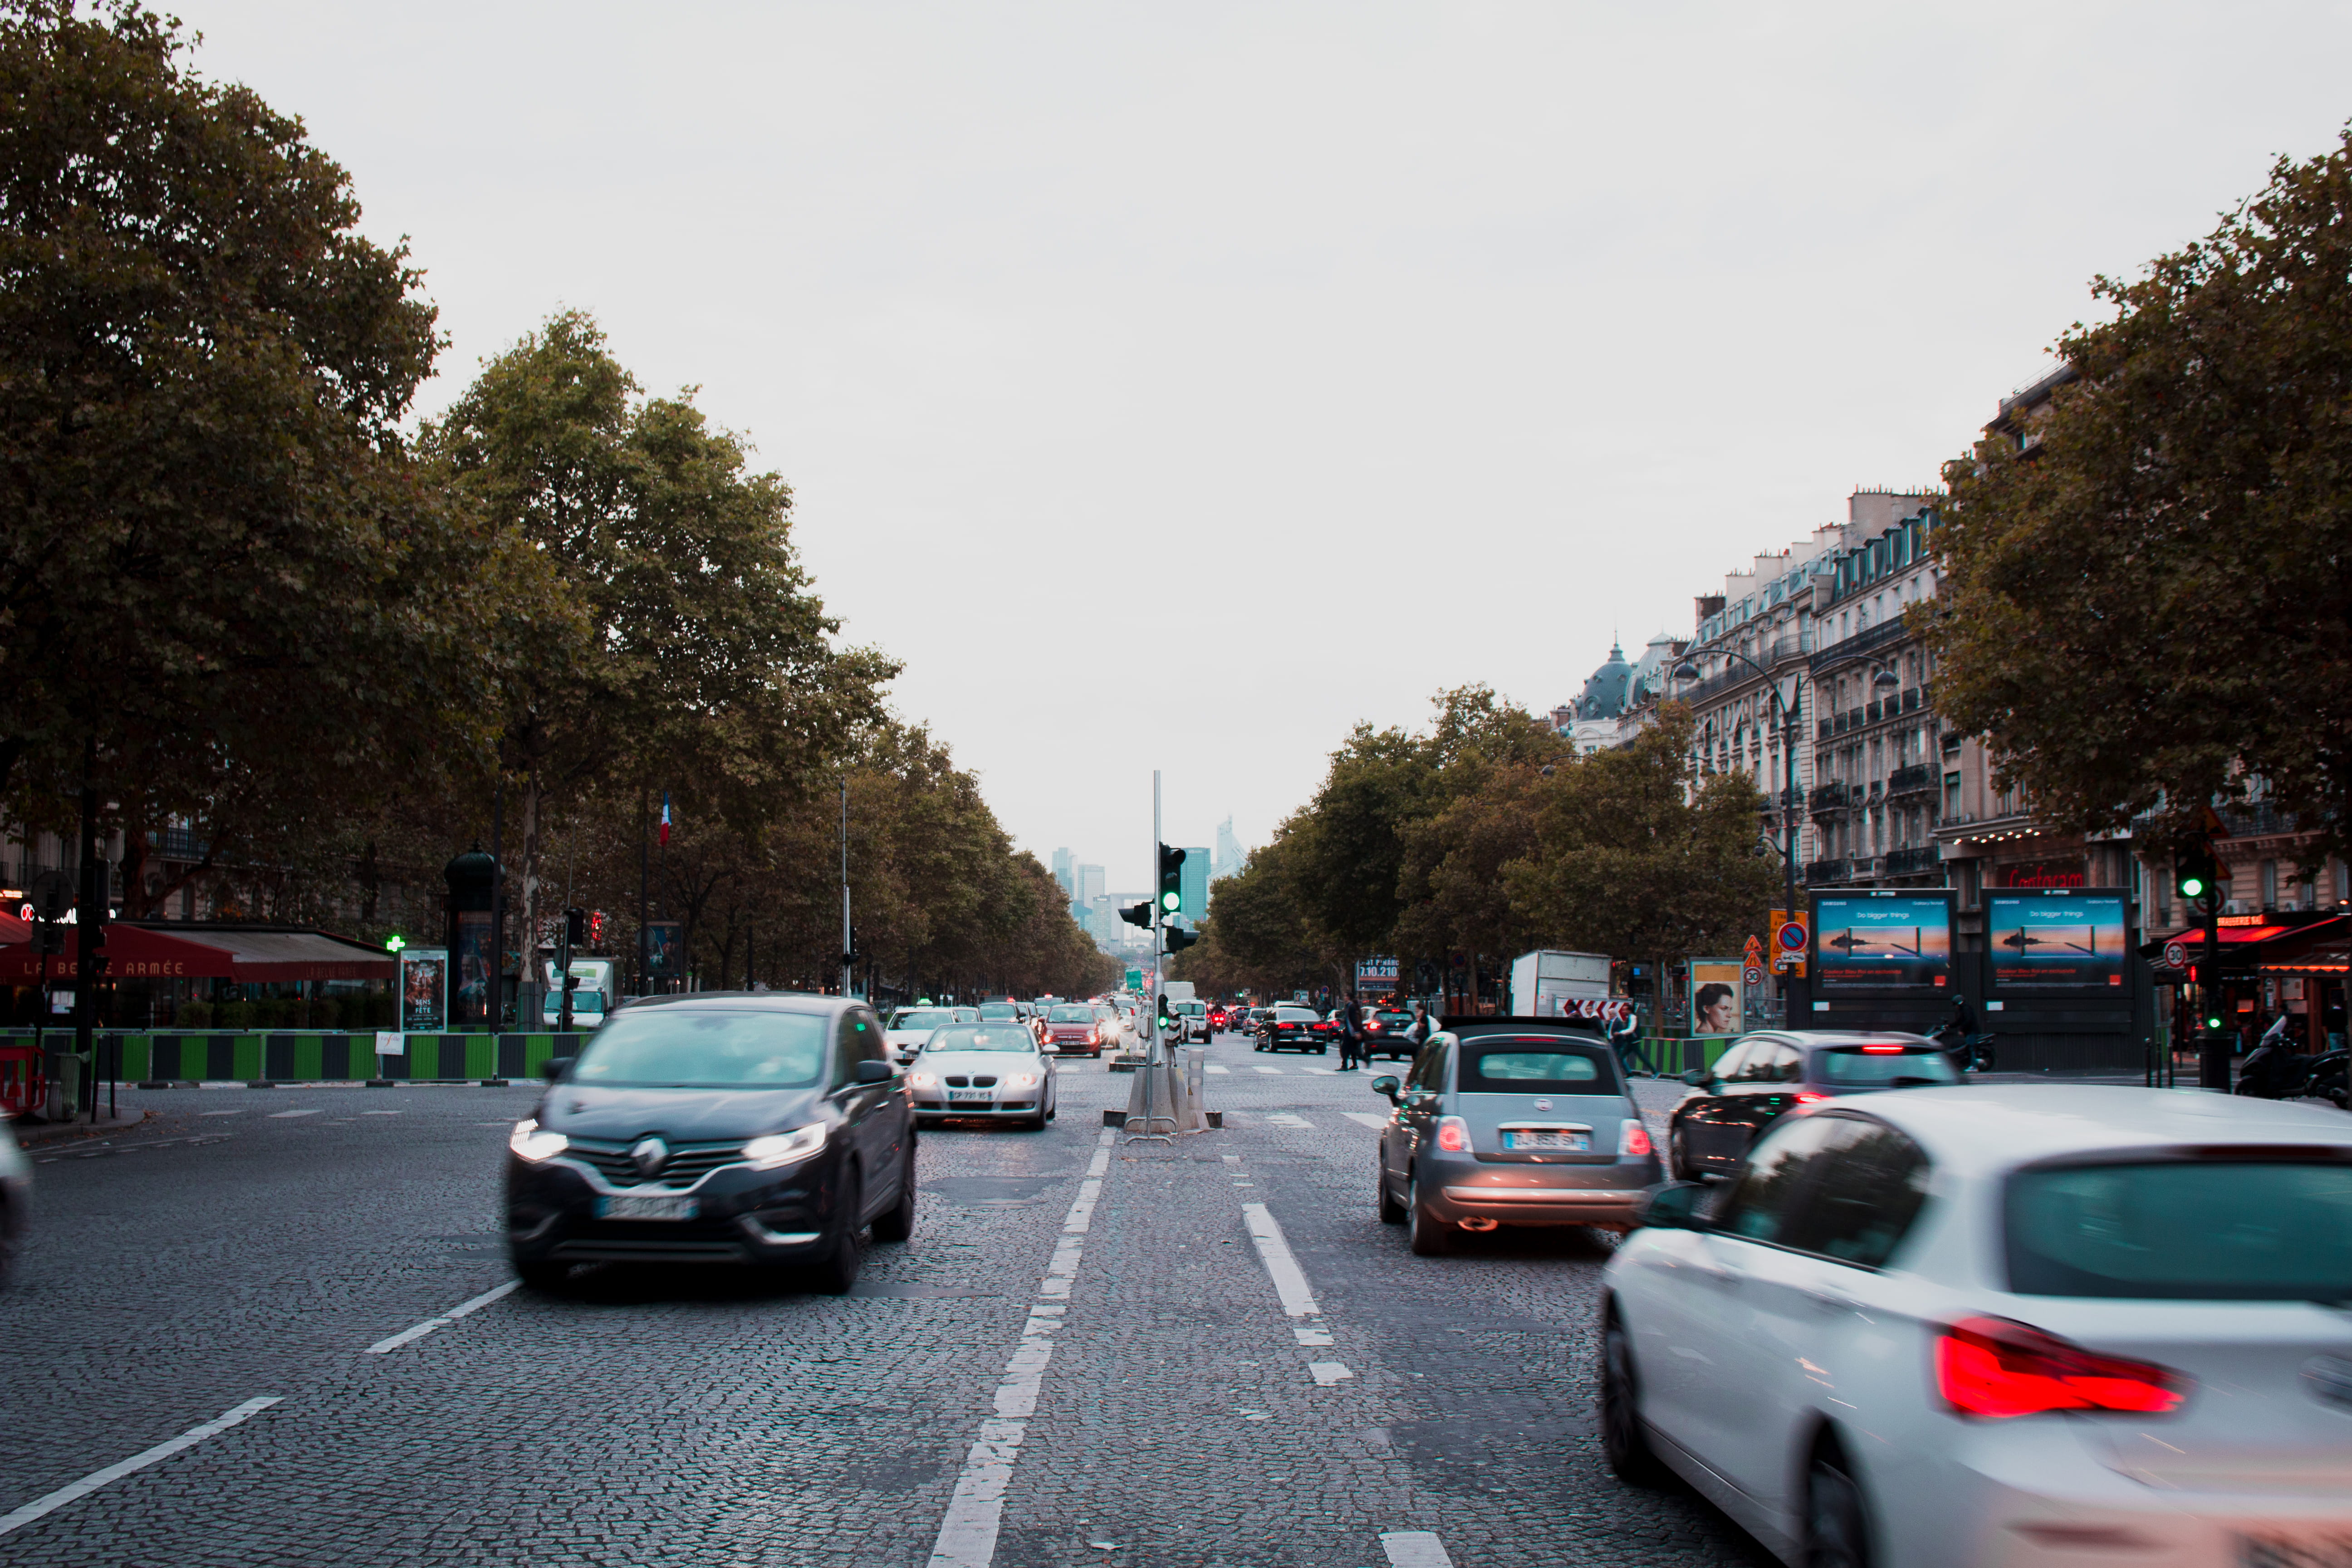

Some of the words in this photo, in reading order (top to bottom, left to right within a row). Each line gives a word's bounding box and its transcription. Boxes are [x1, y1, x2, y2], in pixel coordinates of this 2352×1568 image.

[2170, 950, 2181, 960] 30
[58, 962, 112, 974] BEE
[126, 959, 183, 974] ARMÉE
